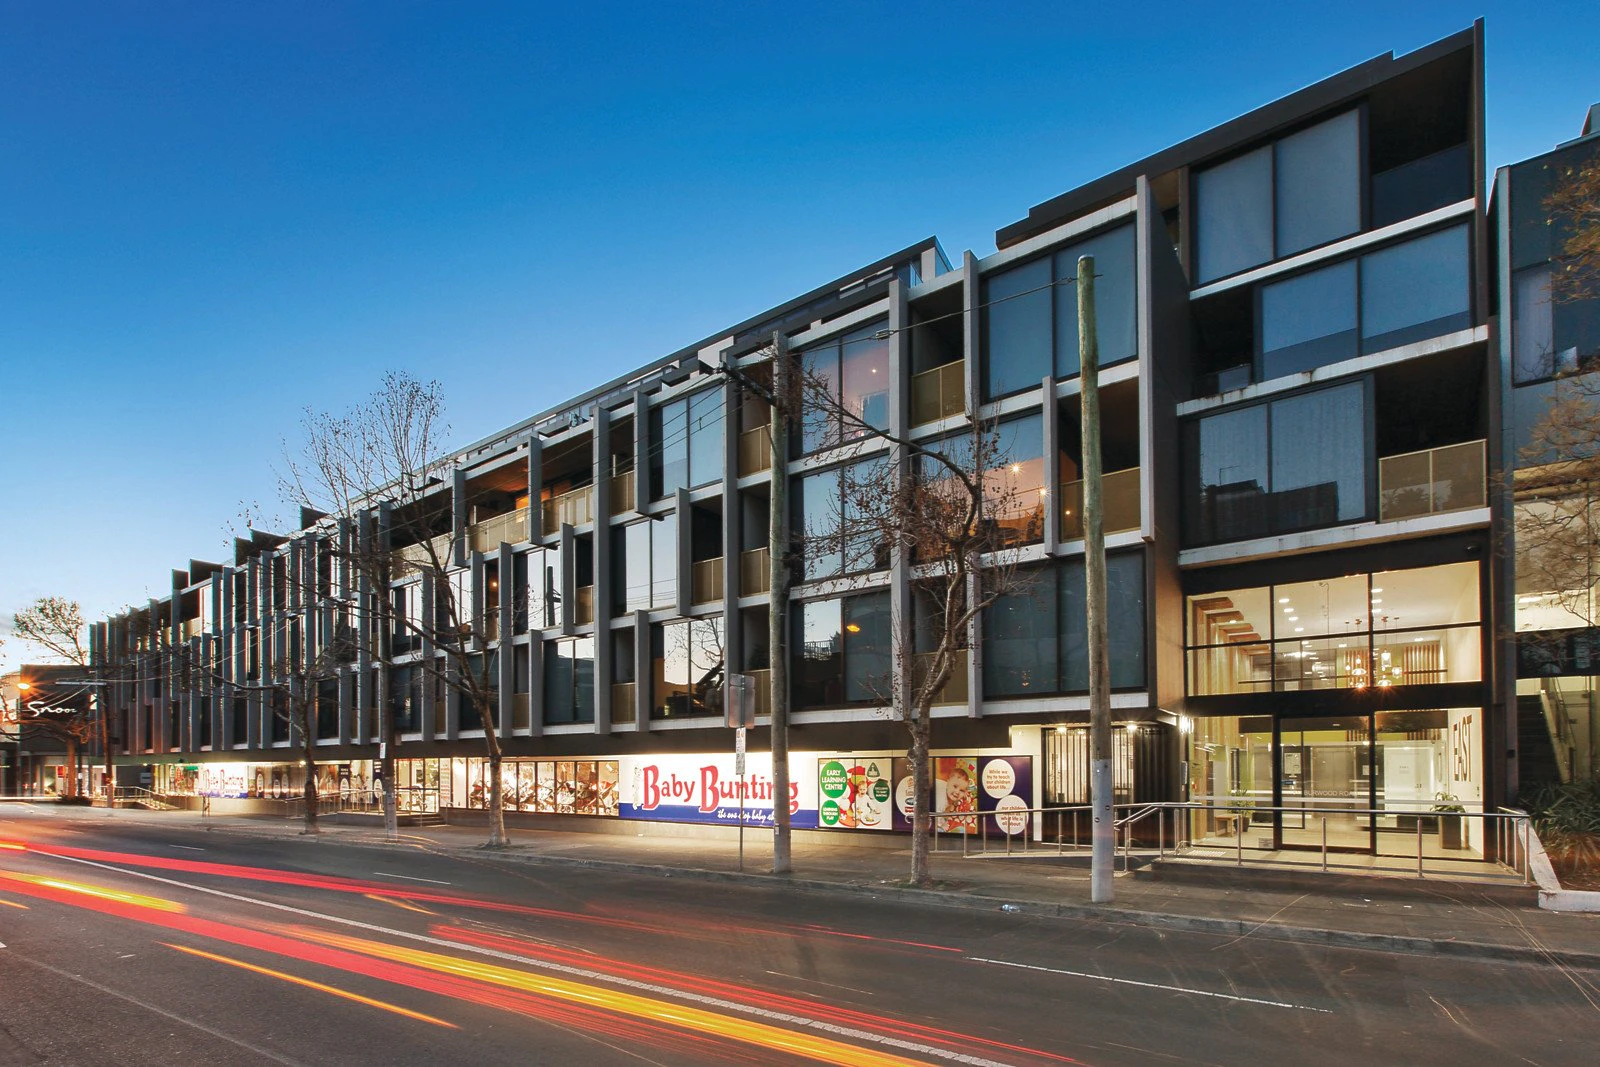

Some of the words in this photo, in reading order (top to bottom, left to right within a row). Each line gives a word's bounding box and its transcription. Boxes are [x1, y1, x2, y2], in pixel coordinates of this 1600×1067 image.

[1453, 715, 1472, 782] EAST
[642, 765, 695, 810] Baby
[1304, 789, 1337, 797] BURWOOD
